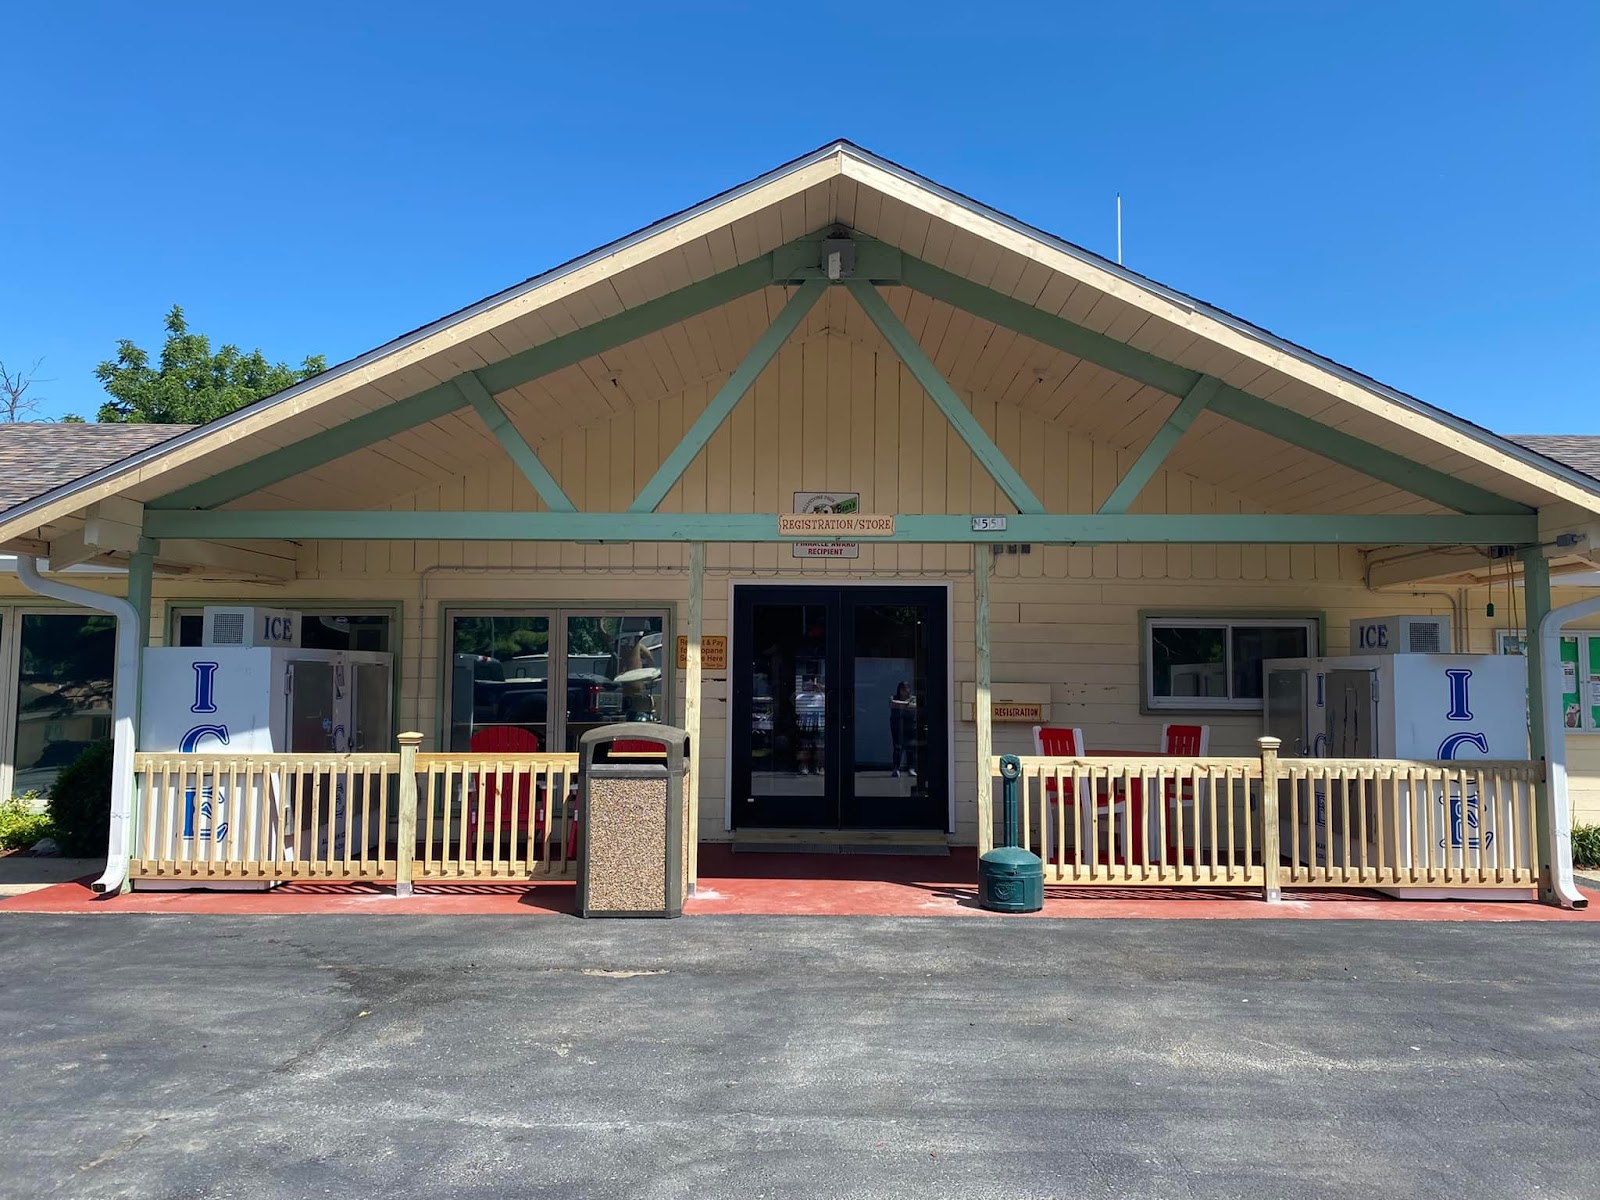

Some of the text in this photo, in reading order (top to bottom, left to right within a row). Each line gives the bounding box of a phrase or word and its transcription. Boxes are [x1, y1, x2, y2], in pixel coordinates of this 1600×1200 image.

[782, 519, 891, 530] REGISTRATION/STORE
[263, 615, 293, 642] ICE
[1359, 624, 1389, 649] ICE
[712, 639, 724, 647] Pay
[994, 707, 1039, 717] REGISTRATION
